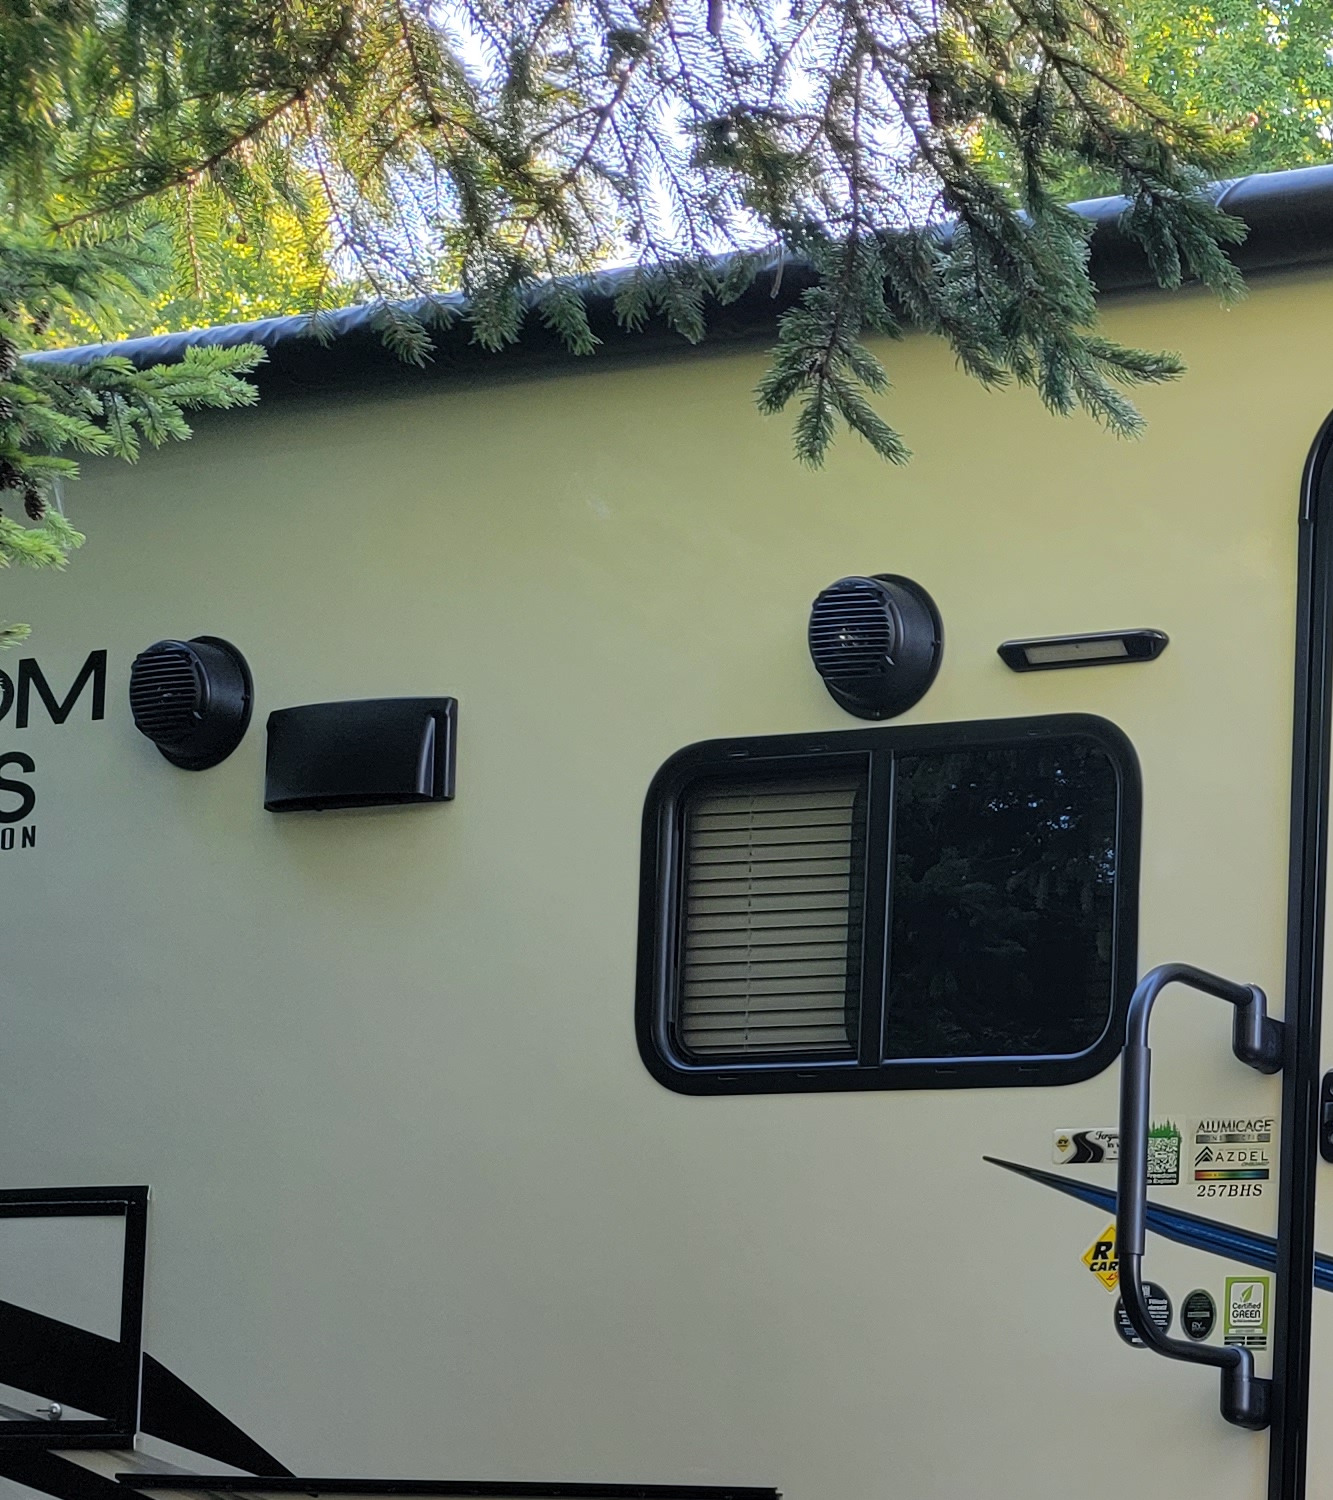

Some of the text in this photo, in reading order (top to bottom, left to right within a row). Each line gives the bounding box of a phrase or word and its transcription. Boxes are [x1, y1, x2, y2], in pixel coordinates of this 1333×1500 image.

[1196, 1119, 1274, 1134] ALUMICAGE
[1215, 1151, 1269, 1162] AZDEL
[1197, 1184, 1263, 1197] 257BHS
[1232, 1302, 1261, 1310] Certified
[1231, 1309, 1261, 1319] GREEN
